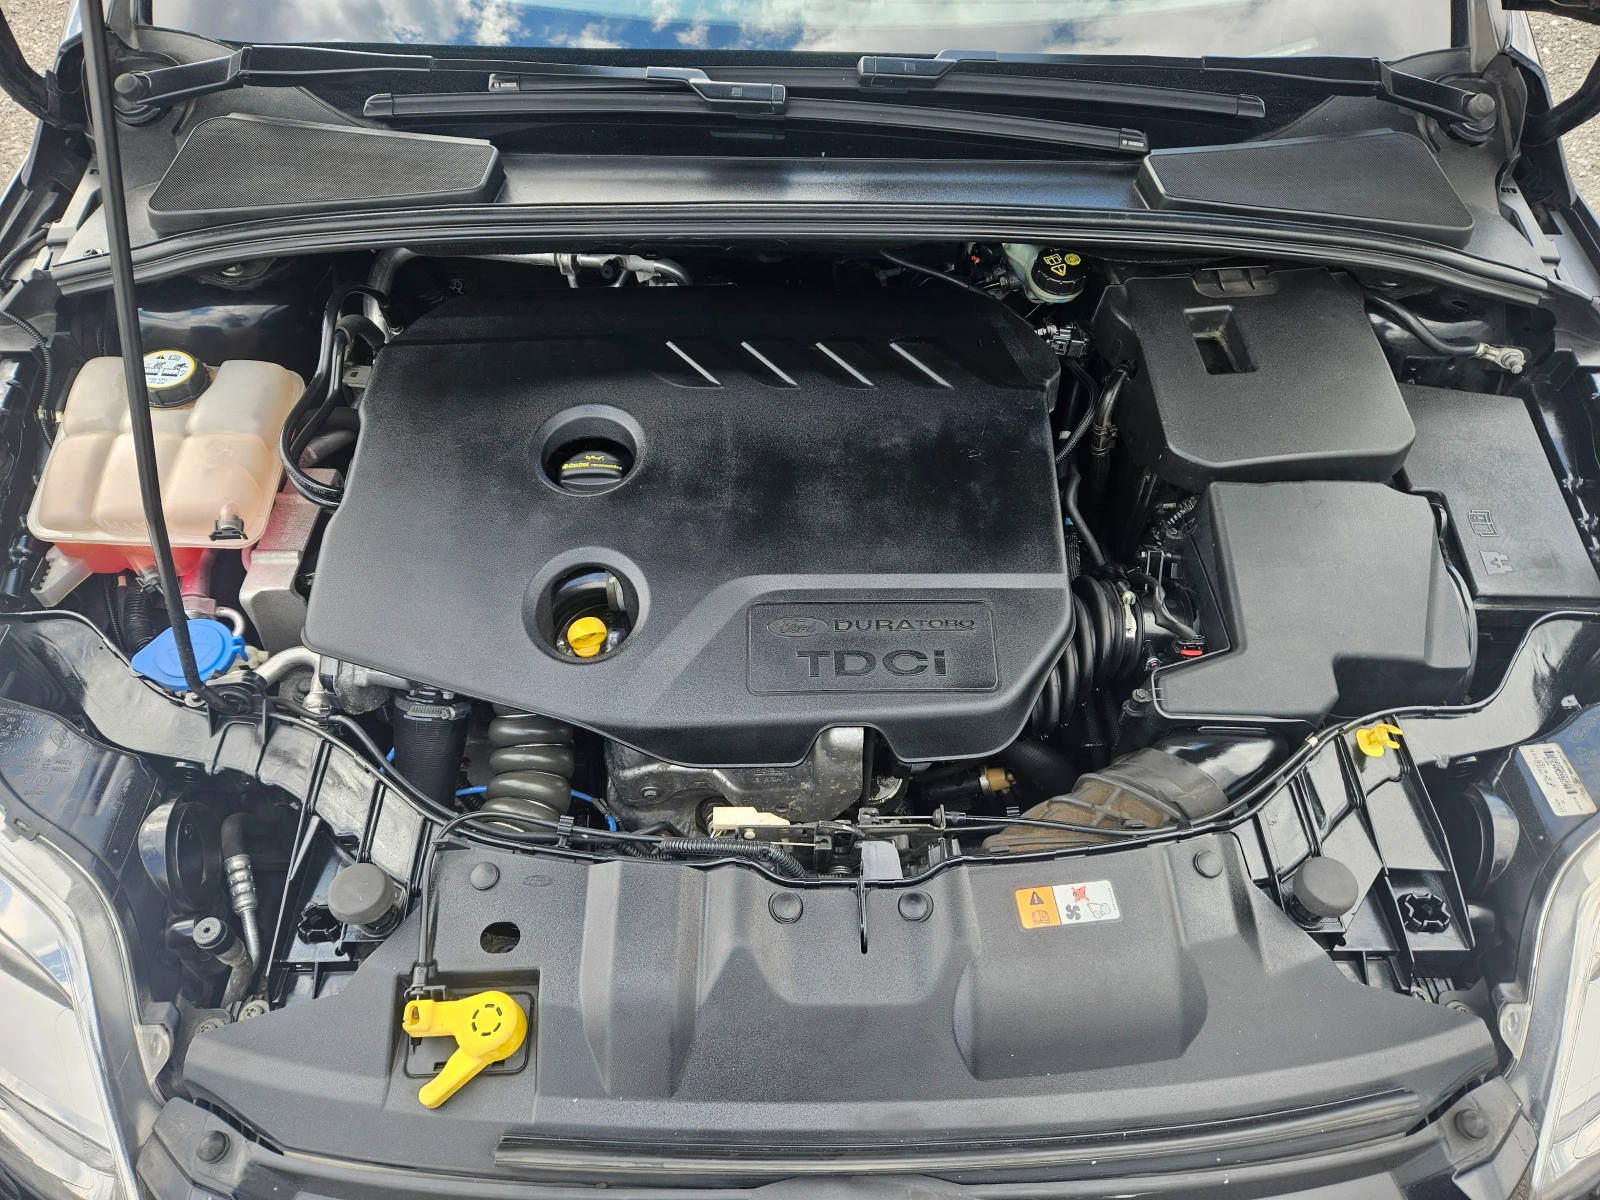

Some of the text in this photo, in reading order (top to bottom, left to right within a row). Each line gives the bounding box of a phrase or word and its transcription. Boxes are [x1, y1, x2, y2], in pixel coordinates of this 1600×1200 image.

[777, 617, 975, 635] Ford DURATORQ
[796, 649, 948, 677] TDCi
